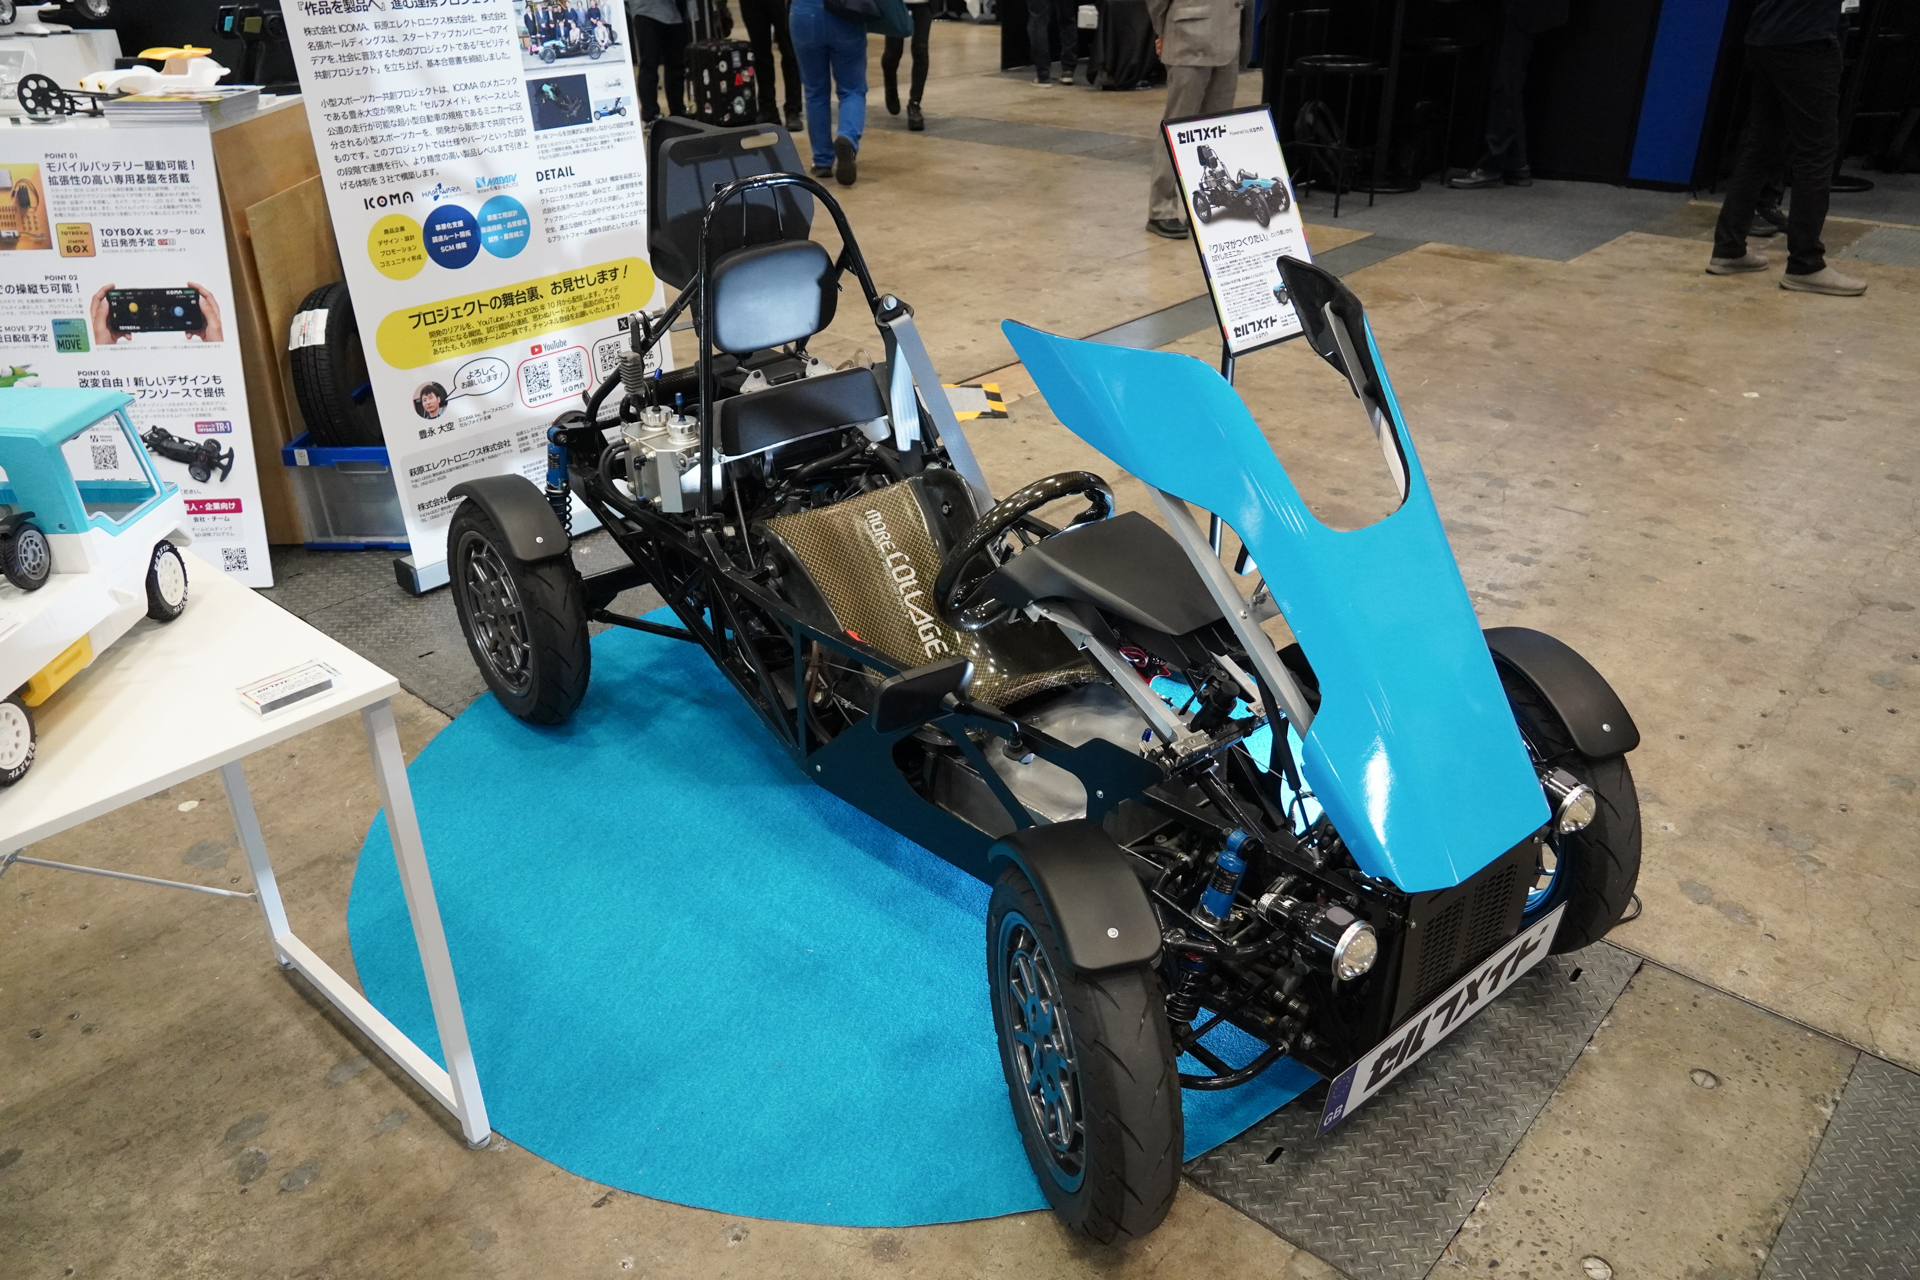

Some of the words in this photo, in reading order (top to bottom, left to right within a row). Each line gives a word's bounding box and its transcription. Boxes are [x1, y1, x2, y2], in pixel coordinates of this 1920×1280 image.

[303, 25, 337, 36] 株式会社
[1177, 124, 1227, 145] セルフメイド
[46, 159, 196, 173] モバイルバッテリー駆動可能！
[48, 173, 191, 186] 拡張性の高い専用基盤を搭載
[536, 165, 575, 182] DETAIL
[100, 228, 142, 237] TOYBOX
[66, 245, 89, 253] BOX
[101, 238, 156, 248] 近日発売予定
[440, 243, 455, 253] SCM
[1208, 233, 1269, 254] 『クルマがつくりたい』
[380, 244, 417, 257] プロモーション
[380, 254, 422, 268] コミュニティ形成
[408, 264, 628, 330] プロジェクトの舞台裏、お見せします！
[1233, 315, 1278, 338] セルフメイド
[57, 339, 82, 350] MOVE
[542, 339, 567, 352] YouTube
[466, 364, 496, 380] よろしく
[78, 374, 222, 388] 改変自由！新しいデザインも
[461, 371, 503, 390] お願いします！
[119, 387, 226, 400] ープンソースで提供
[418, 427, 437, 440] 豊永
[437, 421, 456, 434] 大空
[408, 438, 512, 477] 萩原エレクトロニクス株式会社
[865, 509, 896, 553] MORE
[1363, 924, 1550, 1094] セルフメイド
[1323, 1104, 1344, 1127] GB
